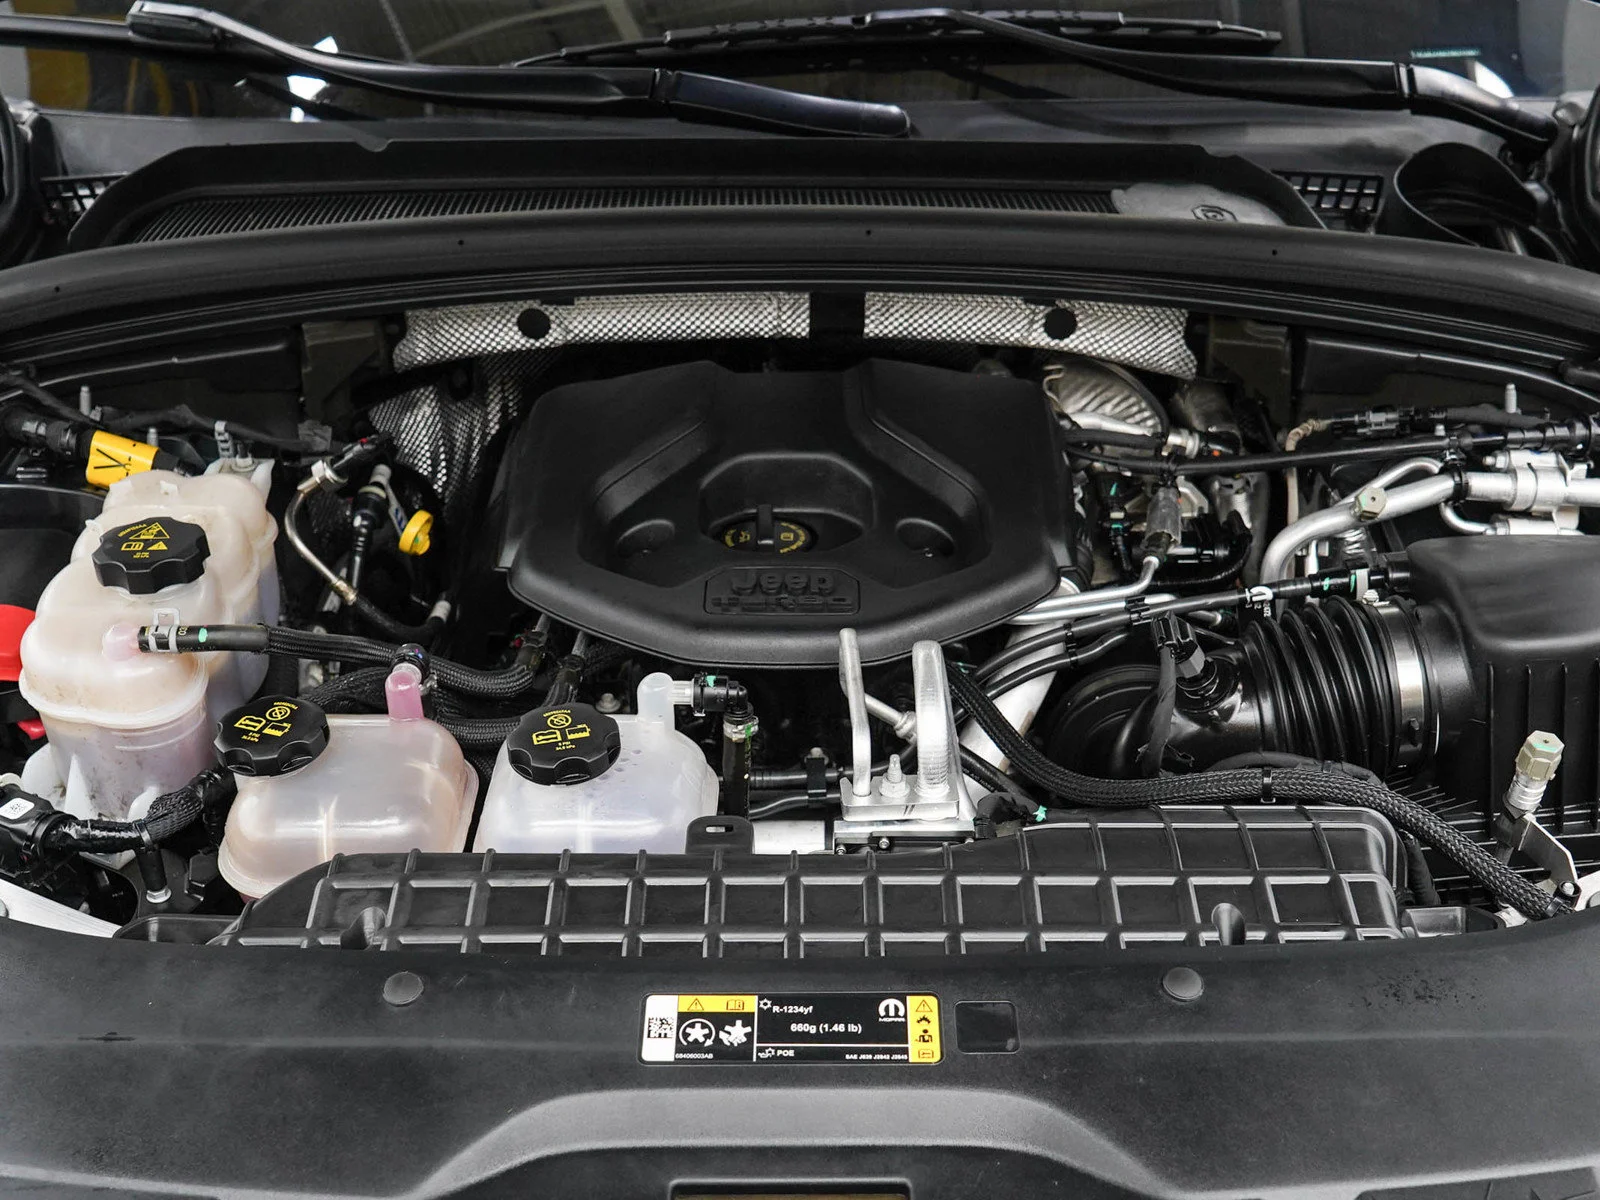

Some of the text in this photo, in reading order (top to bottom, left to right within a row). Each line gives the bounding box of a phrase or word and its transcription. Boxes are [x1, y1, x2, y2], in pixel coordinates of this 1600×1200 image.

[731, 570, 835, 597] Jeep
[772, 1005, 814, 1016] R-1234yf
[790, 1023, 817, 1035] 660g
[847, 1023, 863, 1035] lb)
[776, 1049, 795, 1057] POE
